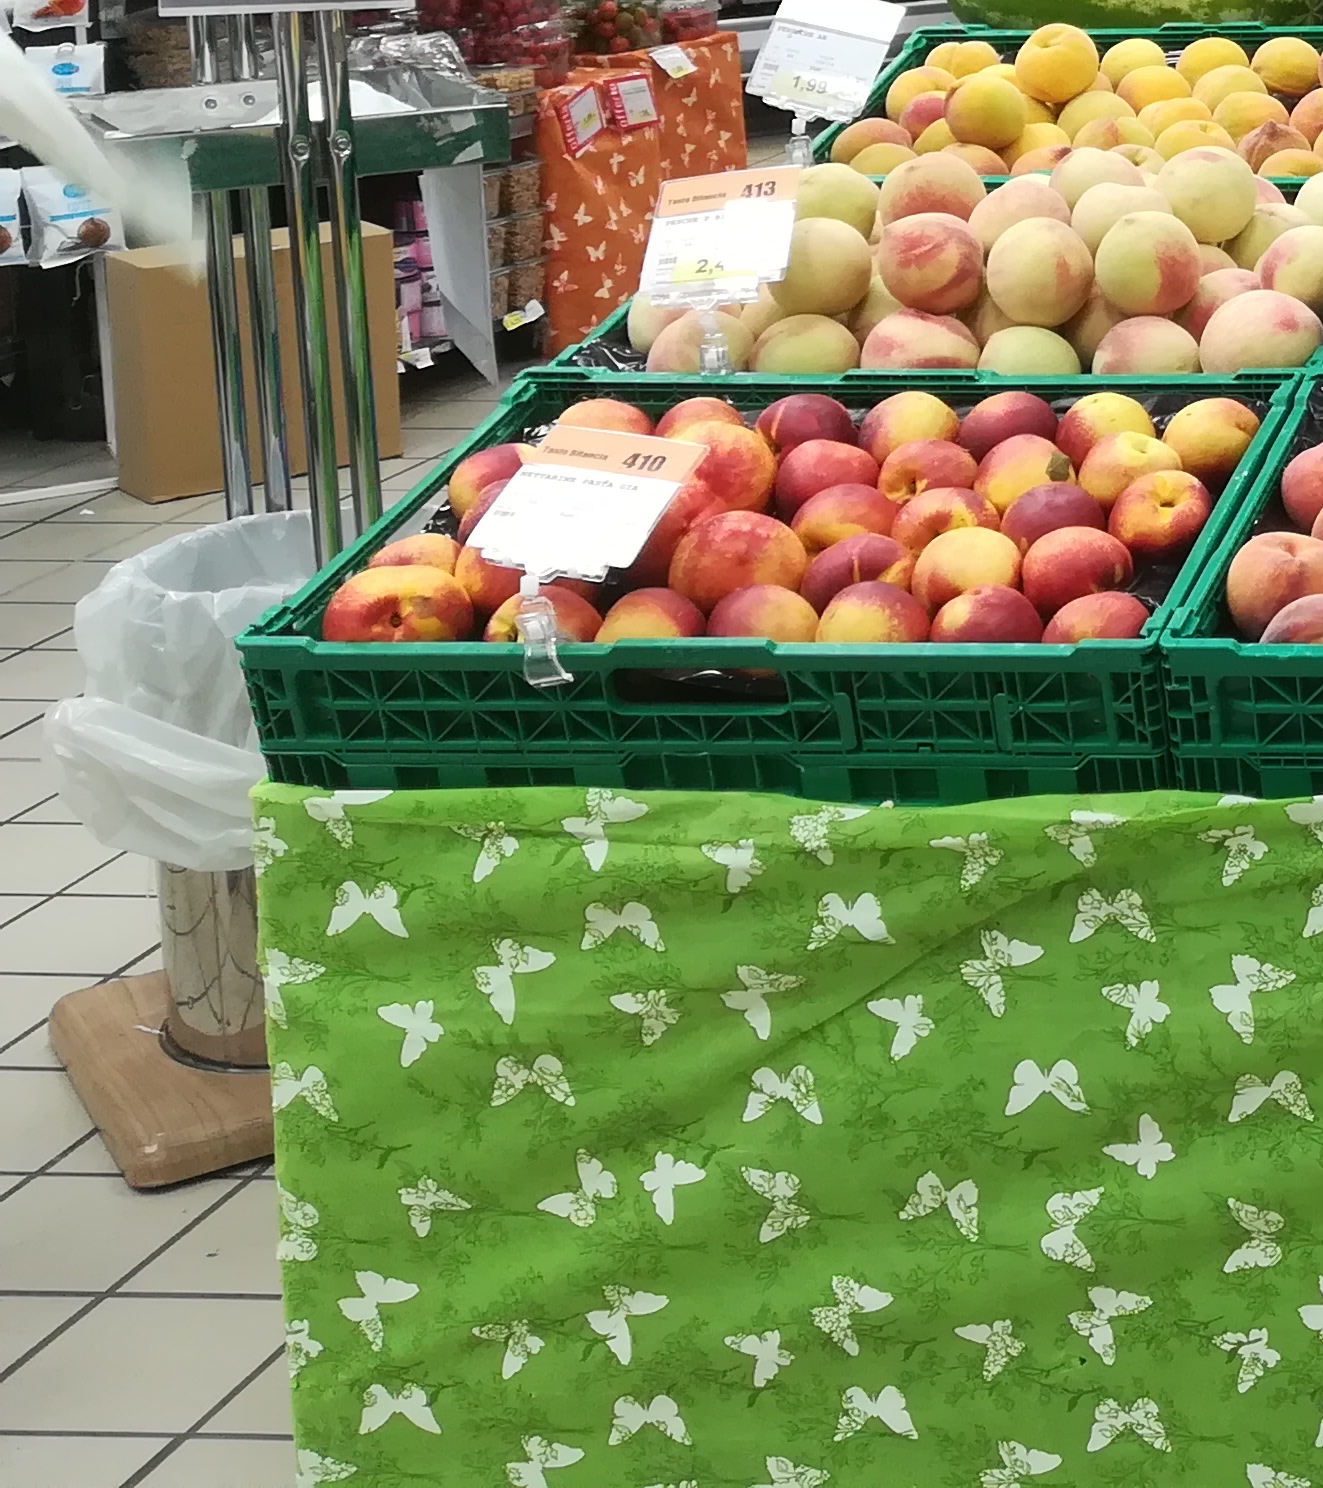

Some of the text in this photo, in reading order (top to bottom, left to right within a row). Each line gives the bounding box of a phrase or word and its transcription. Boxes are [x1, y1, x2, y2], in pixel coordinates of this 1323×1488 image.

[791, 75, 828, 94] 1,99
[740, 180, 777, 200] 413
[621, 452, 668, 473] 410
